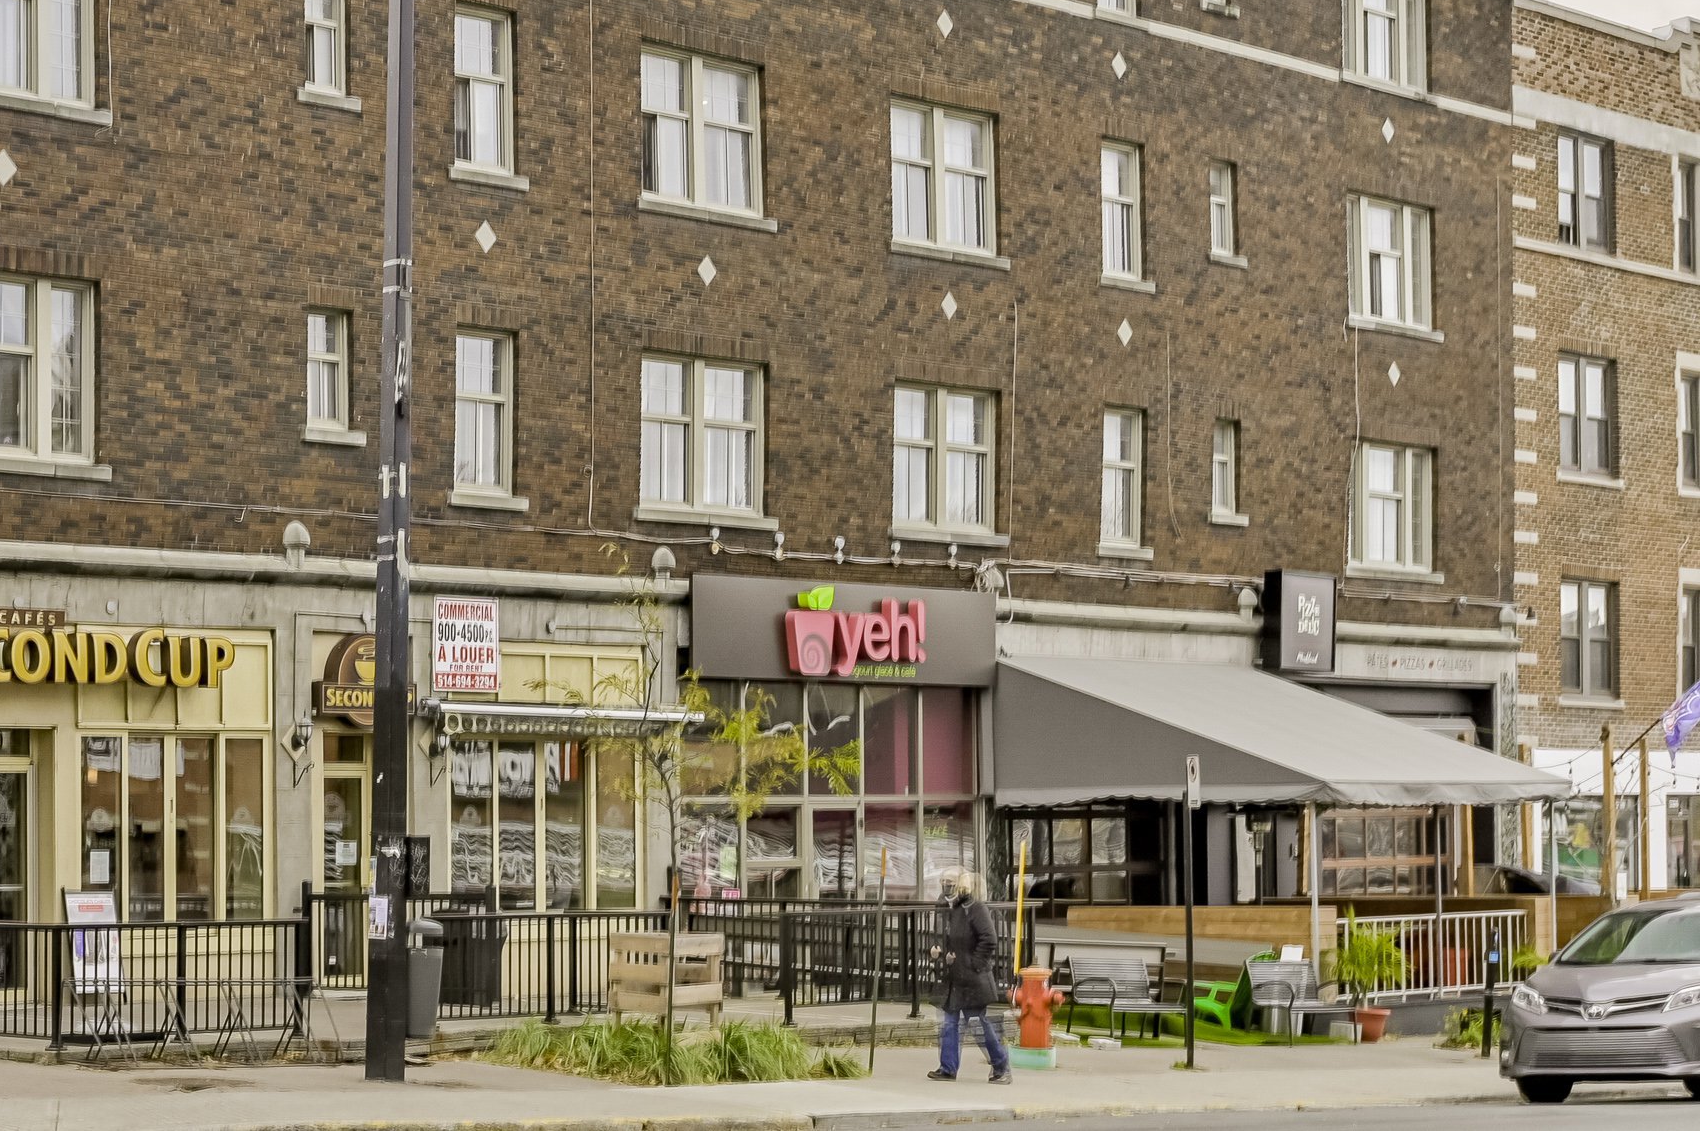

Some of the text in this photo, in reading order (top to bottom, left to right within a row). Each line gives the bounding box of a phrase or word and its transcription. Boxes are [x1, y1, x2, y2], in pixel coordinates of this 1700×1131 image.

[437, 602, 494, 622] COMMERCIAL
[437, 621, 485, 643] 900-4500
[836, 597, 927, 677] yeh!
[437, 643, 494, 664] À LOUER
[449, 664, 484, 673] FOR RENT
[852, 664, 874, 678] gourt
[1399, 655, 1426, 671] PIZZAS
[437, 674, 495, 689] 514-694-3294
